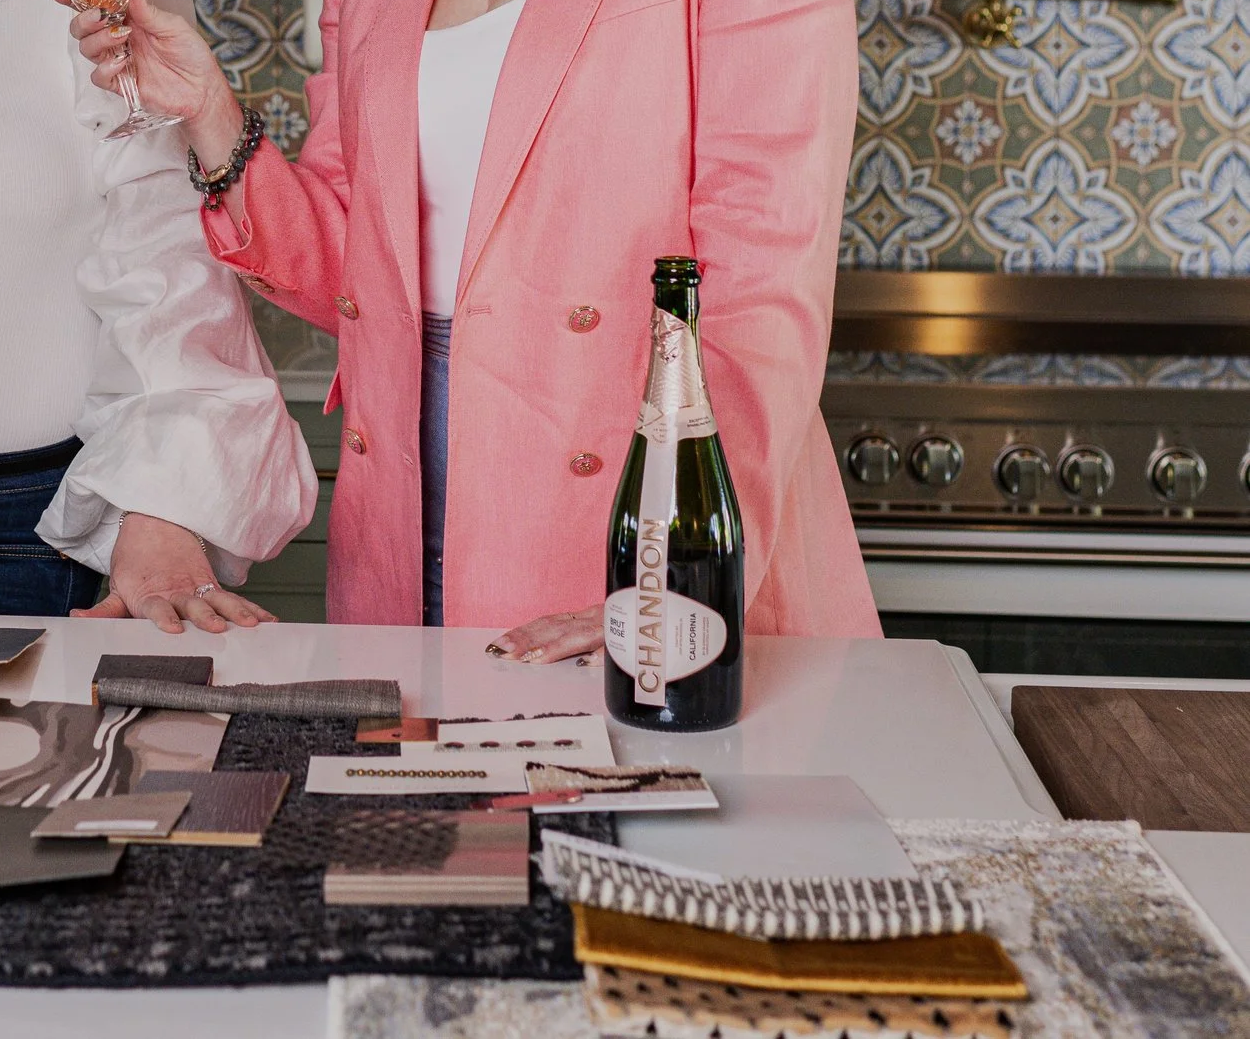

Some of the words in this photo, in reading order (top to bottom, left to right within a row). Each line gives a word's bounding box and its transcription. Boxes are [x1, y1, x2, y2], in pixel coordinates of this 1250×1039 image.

[609, 617, 626, 629] BRUT
[637, 518, 665, 693] CHANDON
[689, 612, 698, 661] CALIFORNIA
